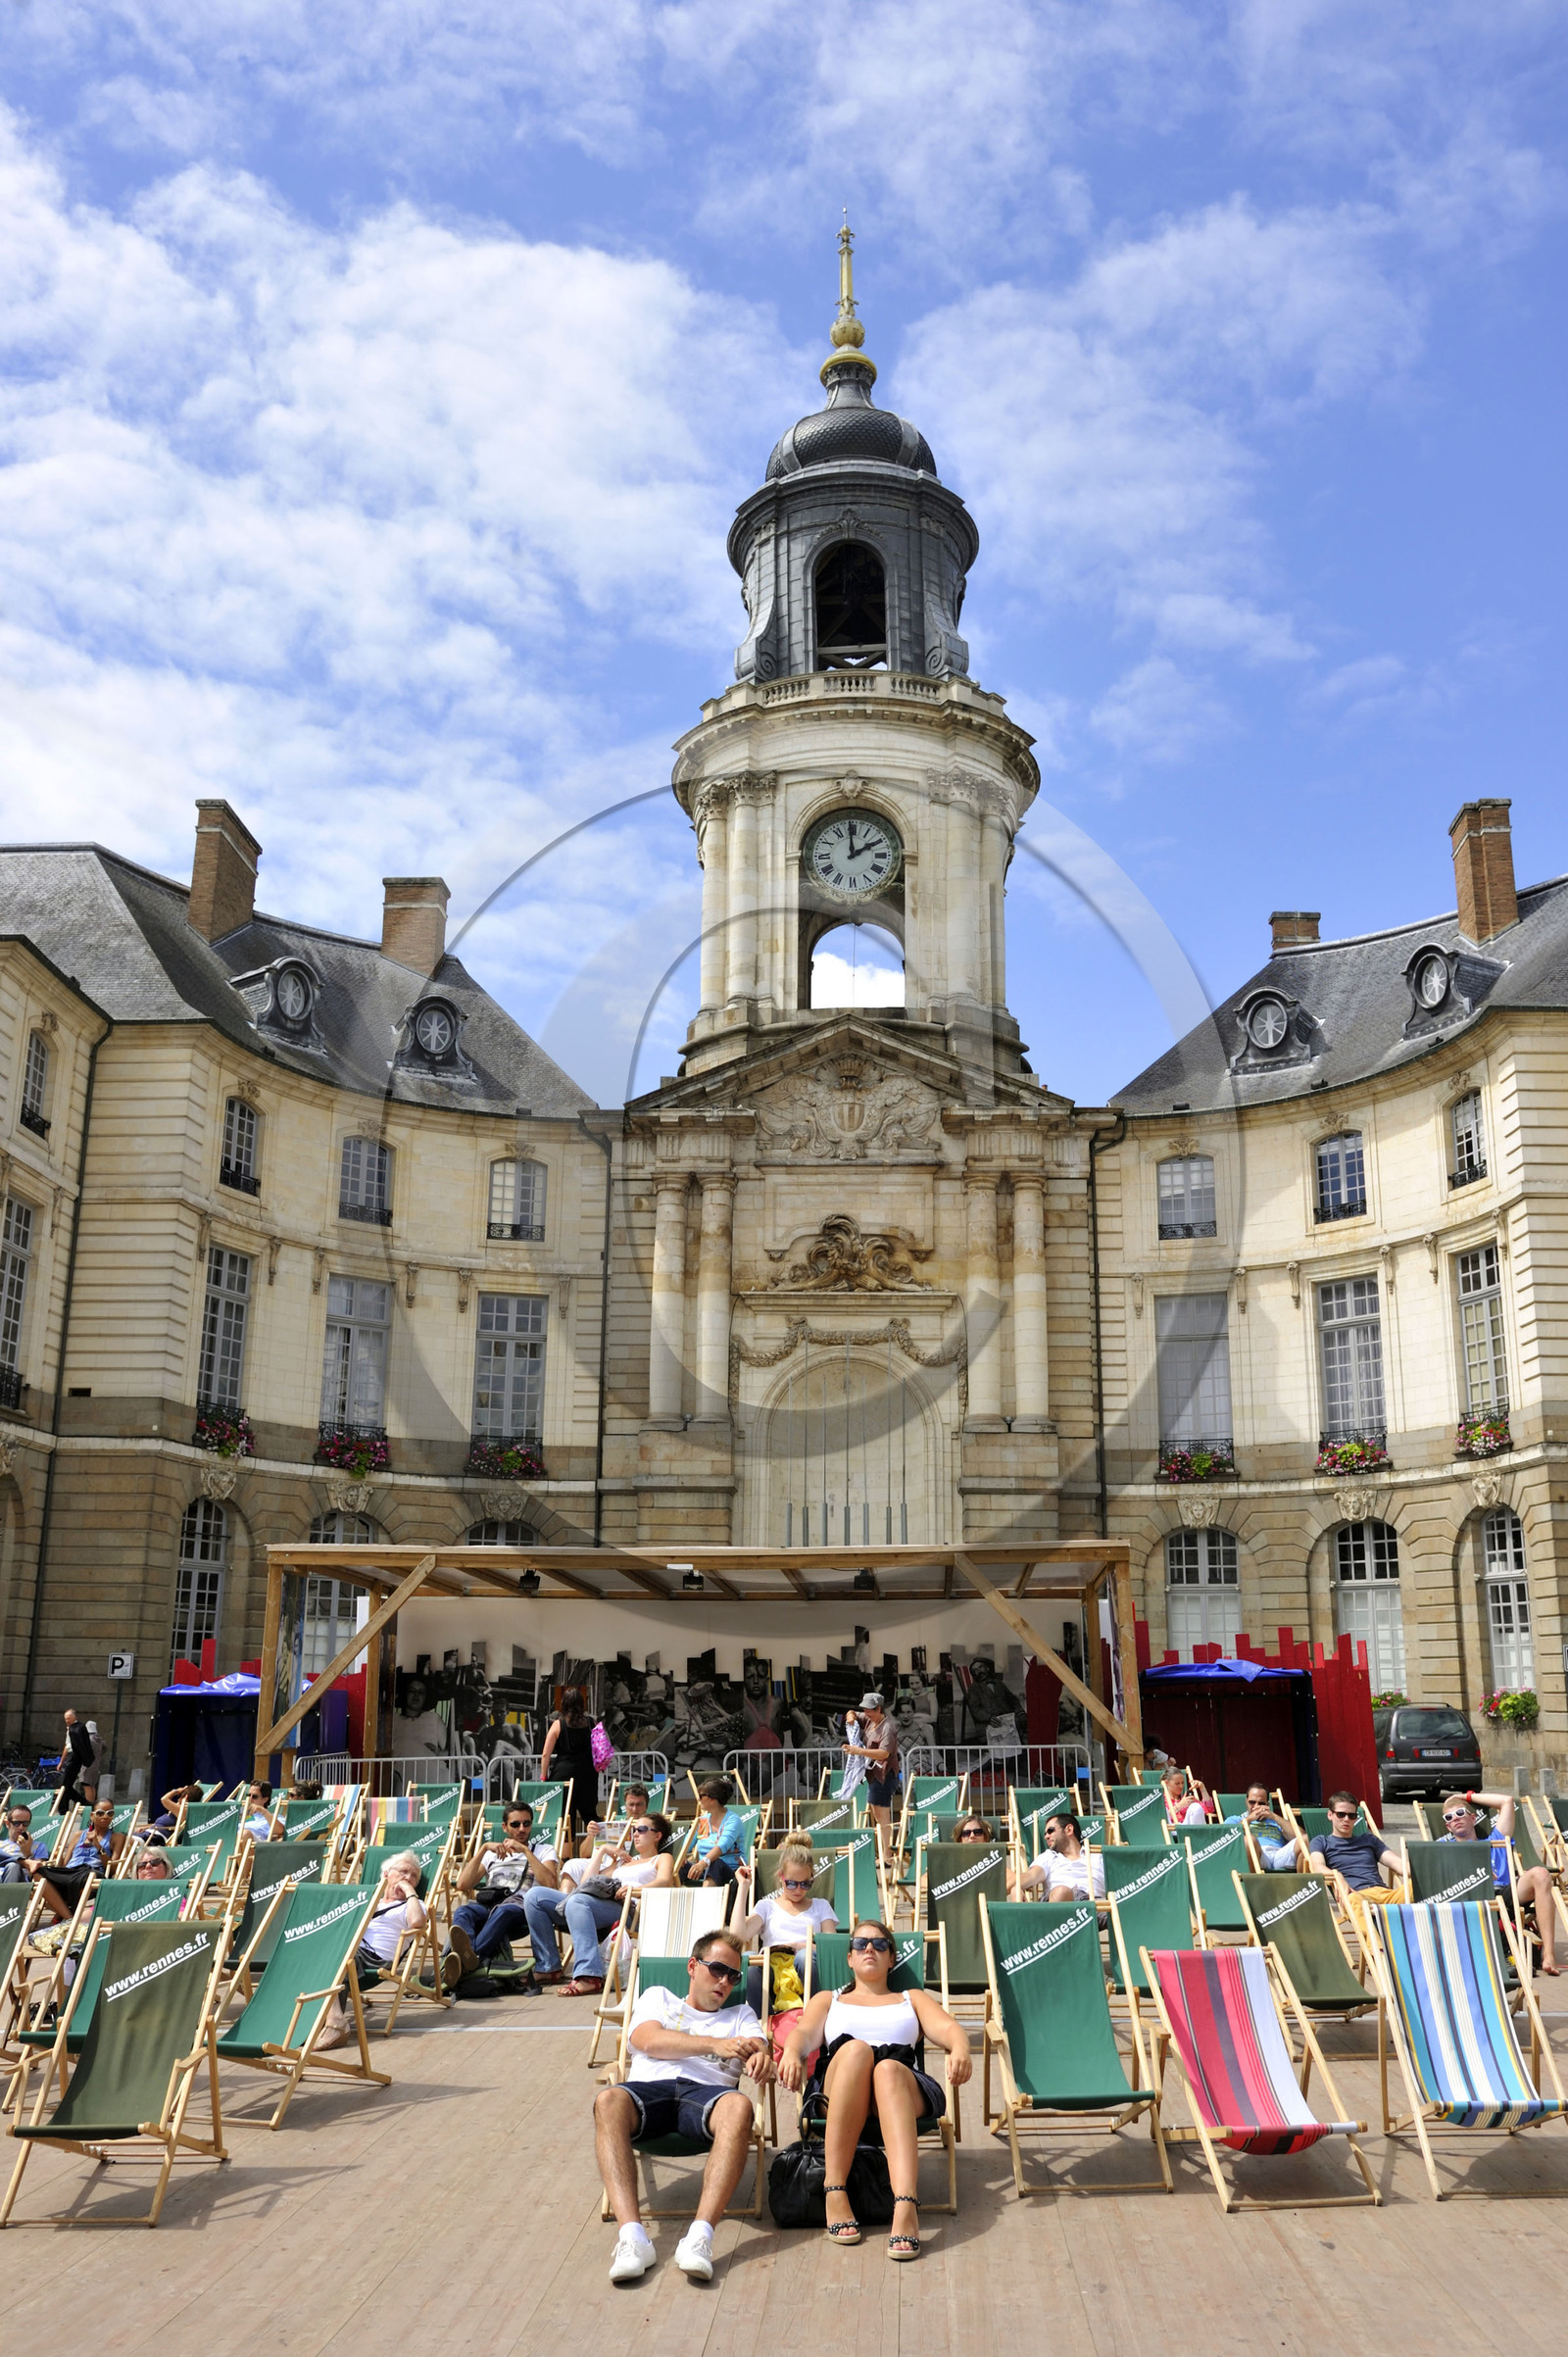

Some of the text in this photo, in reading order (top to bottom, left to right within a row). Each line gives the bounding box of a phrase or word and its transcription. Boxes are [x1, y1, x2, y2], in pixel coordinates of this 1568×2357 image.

[111, 1656, 124, 1675] P
[915, 1781, 956, 1807] www.rennes.fr
[1119, 1788, 1160, 1819] www.rennes.fr
[187, 1804, 237, 1836] www.rennes.fr
[286, 1803, 336, 1835] www.rennes.fr
[931, 1849, 1000, 1896] www.rennes.fr
[284, 1891, 368, 1939] www.rennes.fr
[1256, 1881, 1318, 1924] www.rennes.fr
[1001, 1907, 1089, 1971] www.rennes.fr
[104, 1932, 208, 1997] www.rennes.fr
